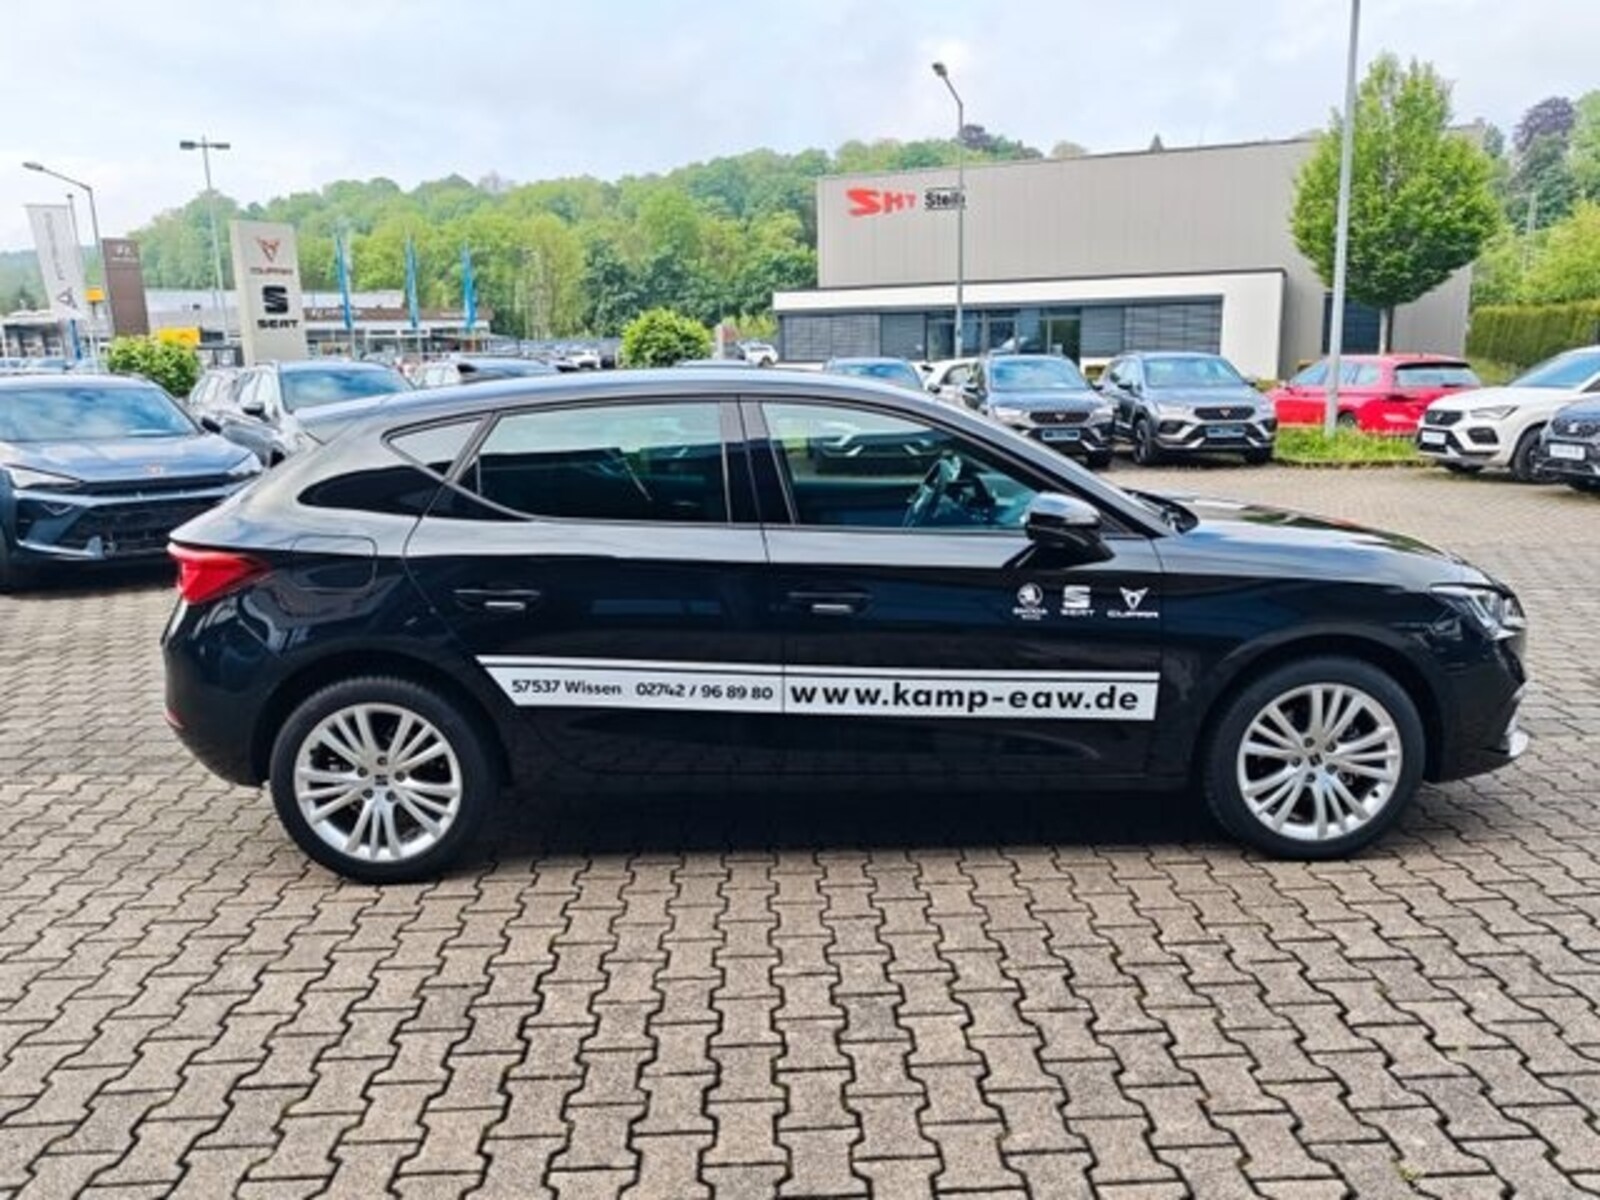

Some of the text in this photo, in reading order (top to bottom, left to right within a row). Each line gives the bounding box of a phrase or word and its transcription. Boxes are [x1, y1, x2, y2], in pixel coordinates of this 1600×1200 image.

[512, 680, 560, 693] 57537
[564, 681, 621, 695] Wissen
[635, 682, 685, 697] 02742
[701, 685, 722, 697] 96
[726, 685, 747, 698] 89
[751, 686, 773, 699] 80
[790, 682, 1138, 713] www.kamp-eaw.de
